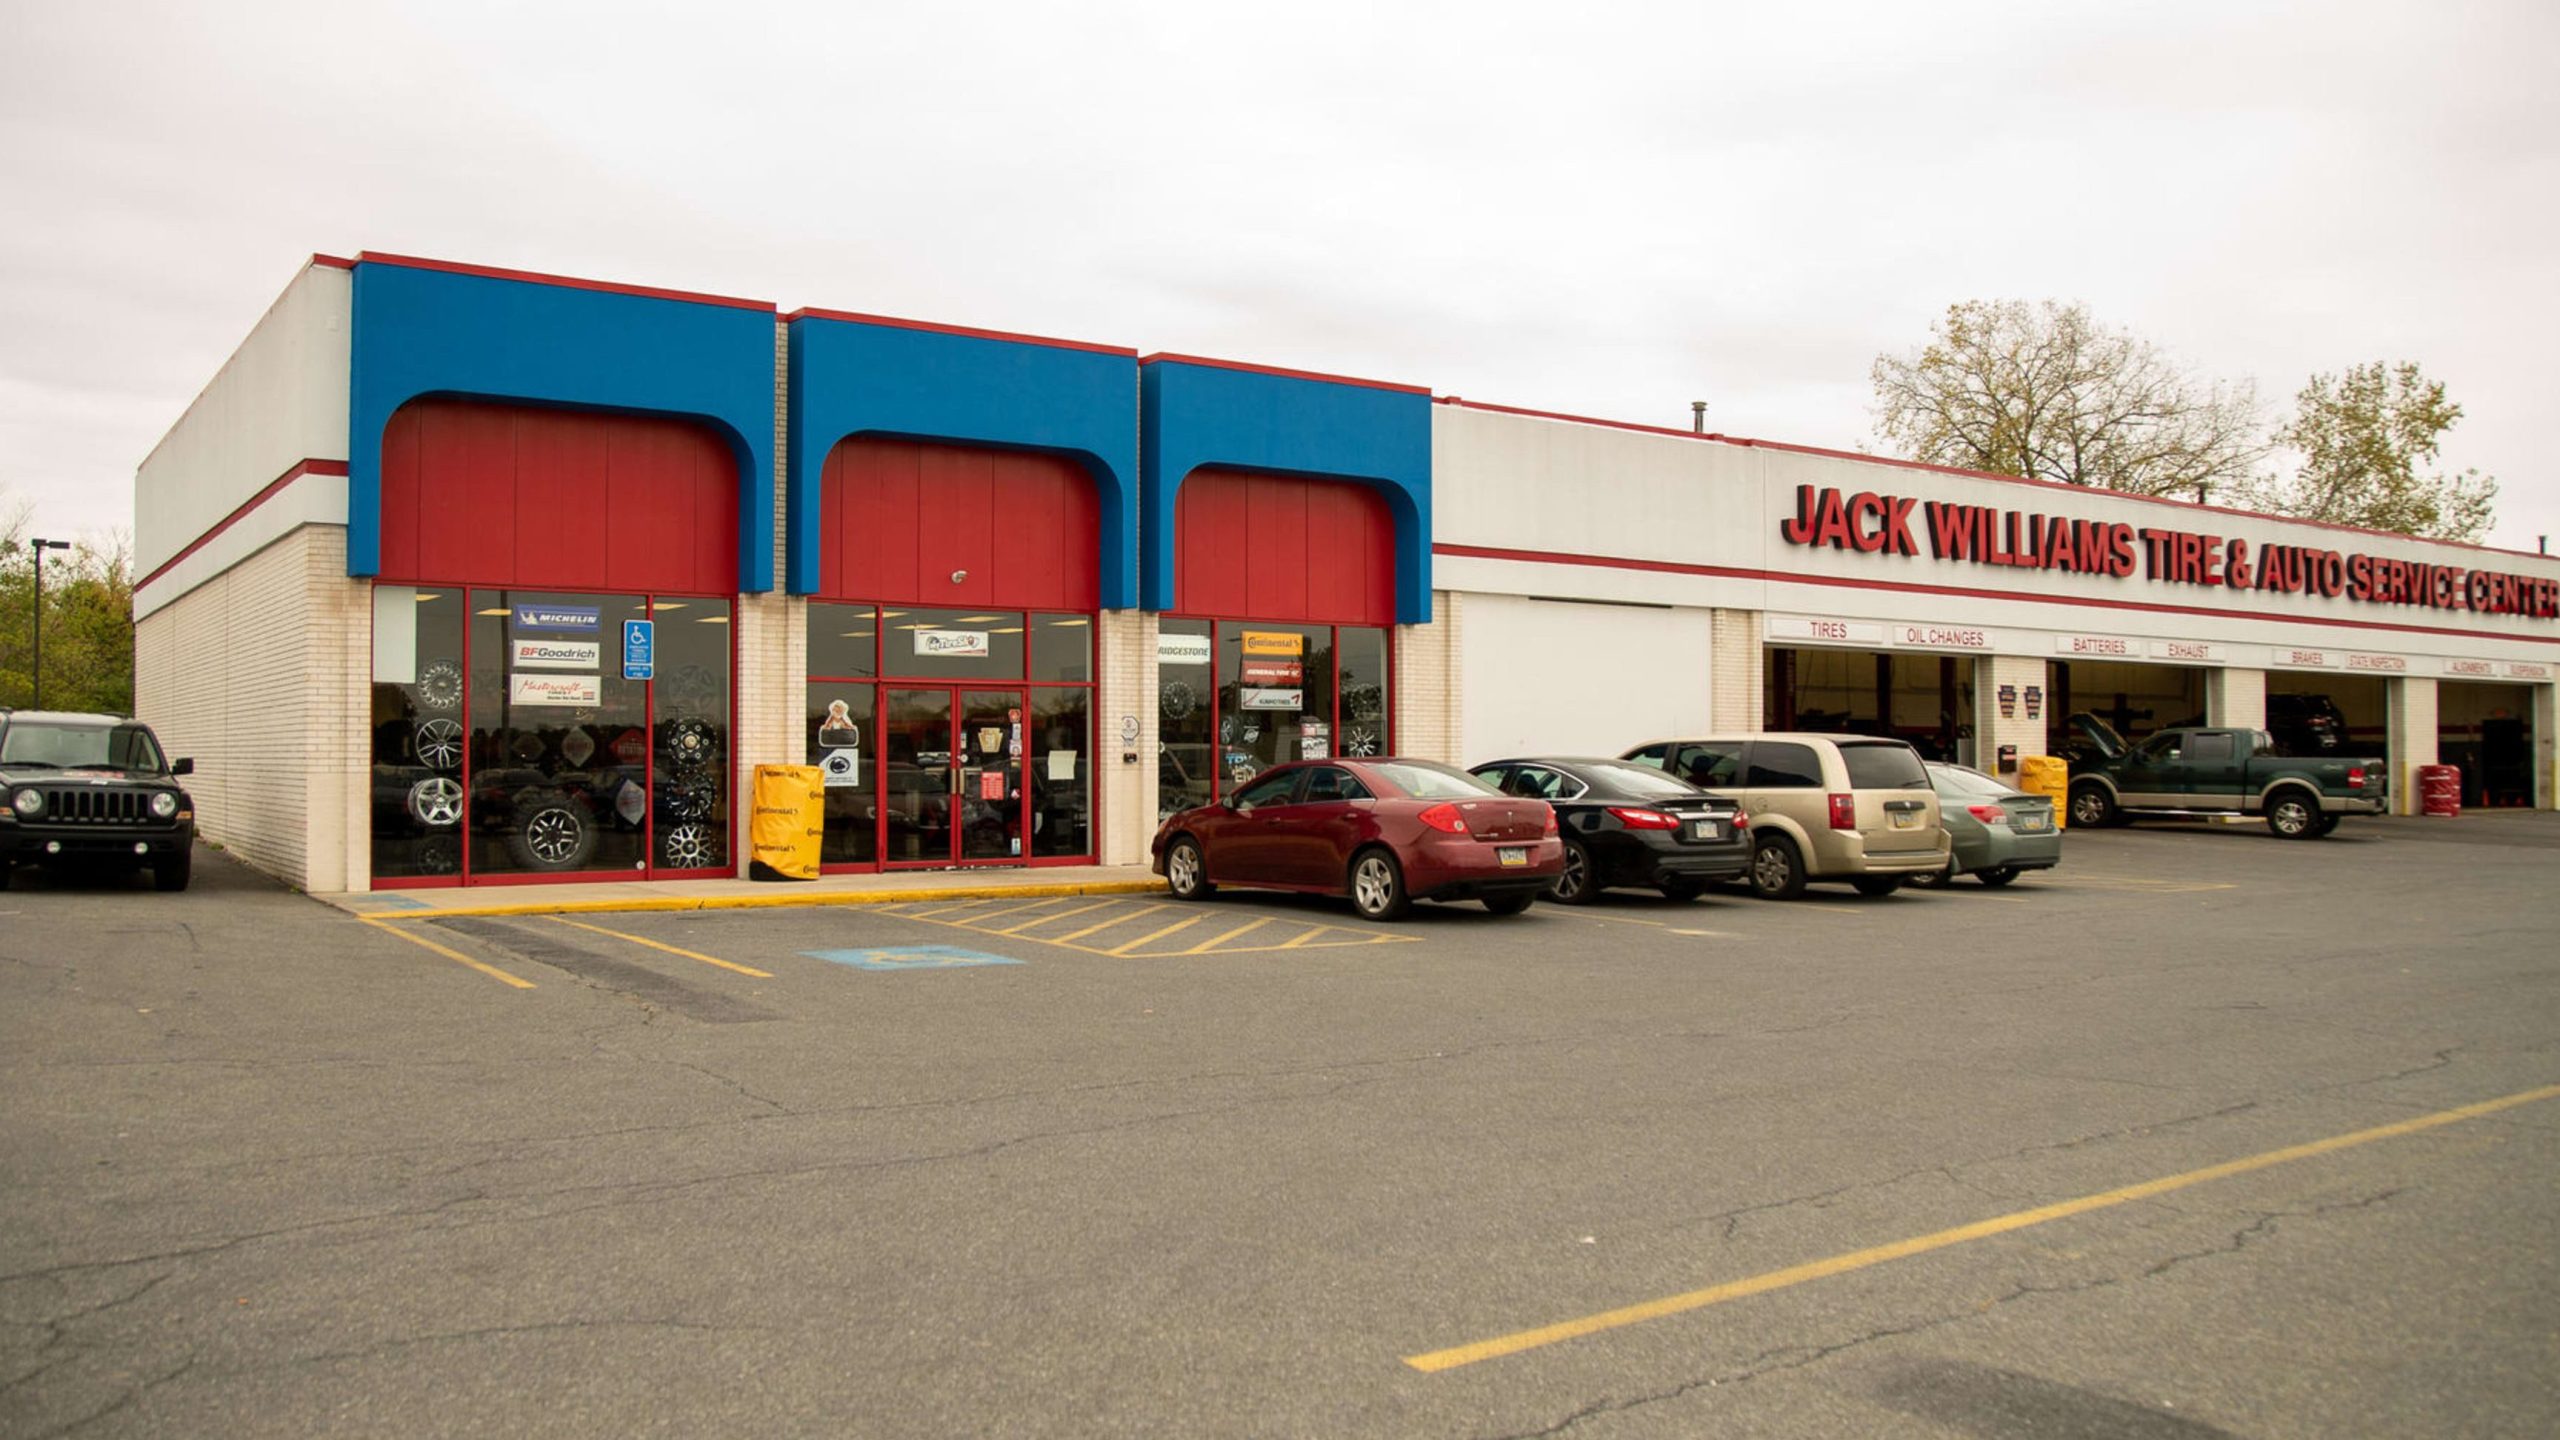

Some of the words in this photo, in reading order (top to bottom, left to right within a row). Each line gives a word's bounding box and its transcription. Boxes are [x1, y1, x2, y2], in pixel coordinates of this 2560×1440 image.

[1781, 484, 1919, 557] JACK
[1925, 501, 2136, 578] WILLIAMS
[2139, 528, 2223, 585] TIRE
[2225, 538, 2256, 589] &
[2256, 543, 2346, 598] AUTO
[2346, 553, 2466, 609] SERVICE
[2465, 570, 2560, 619] CENTER
[539, 614, 597, 624] MICHELIN
[1810, 622, 1847, 639] TIRES
[1907, 627, 1926, 643] OIL
[1929, 629, 1984, 647] CHANGES
[1247, 636, 1292, 649] Continental
[2073, 638, 2126, 654] BATTERIES
[519, 646, 596, 658] BFGoodrich
[1158, 646, 1209, 656] RIDGESTONE
[2168, 643, 2209, 658] EXHAUST
[2292, 651, 2323, 665] BRAKES
